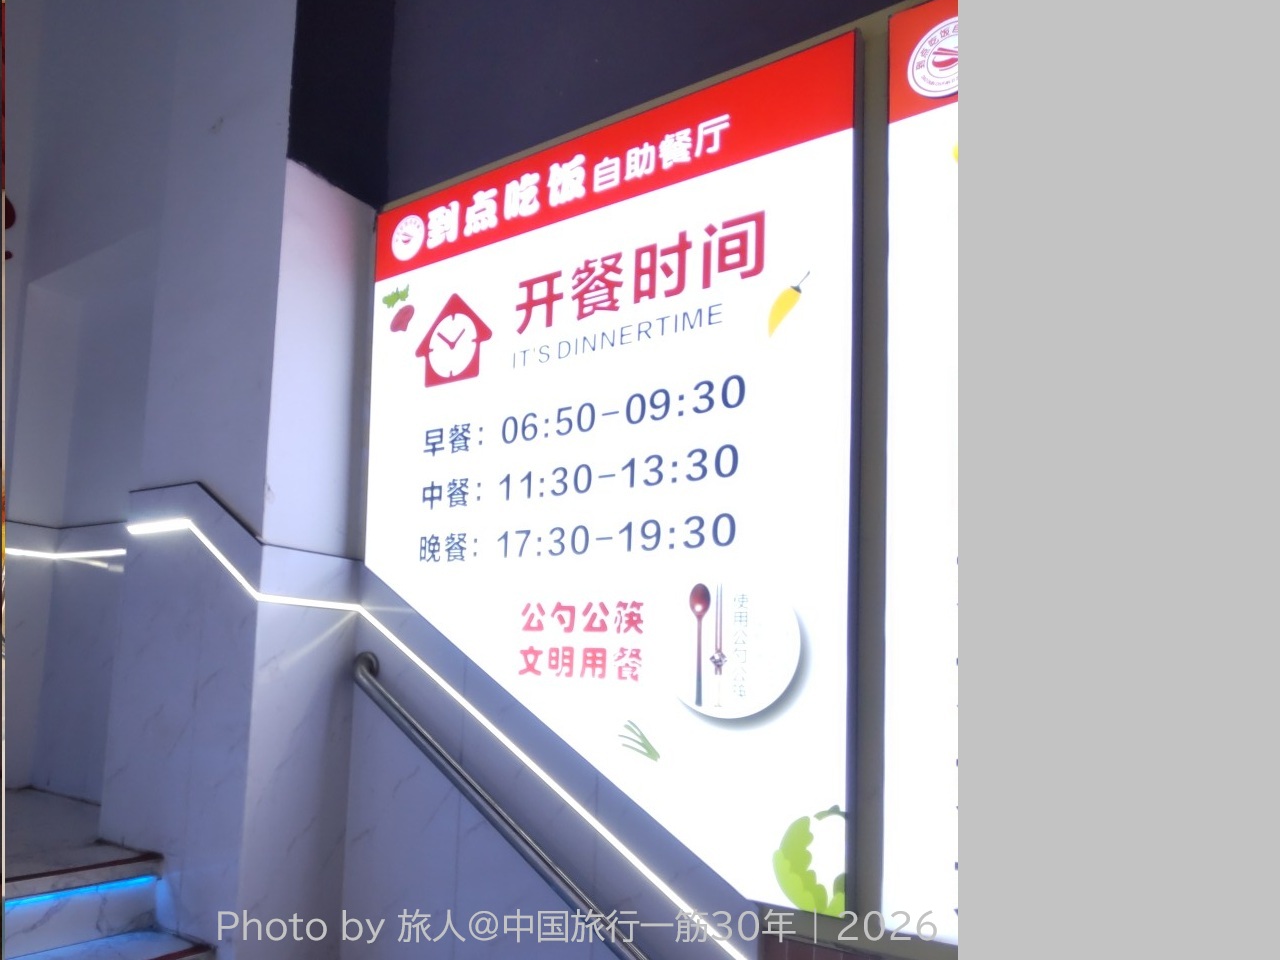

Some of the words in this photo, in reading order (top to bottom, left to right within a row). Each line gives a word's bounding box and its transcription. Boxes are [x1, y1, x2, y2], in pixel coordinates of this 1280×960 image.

[426, 154, 587, 250] 到点吃饭
[592, 114, 731, 191] 自助餐厅
[516, 210, 766, 335] 开餐时间
[501, 374, 747, 445] 06:50-09:30
[498, 443, 740, 502] 11:30-13:30
[496, 512, 737, 559] 17:30-19:30
[521, 600, 645, 636] 公勺公筷
[519, 645, 643, 682] 文明用餐
